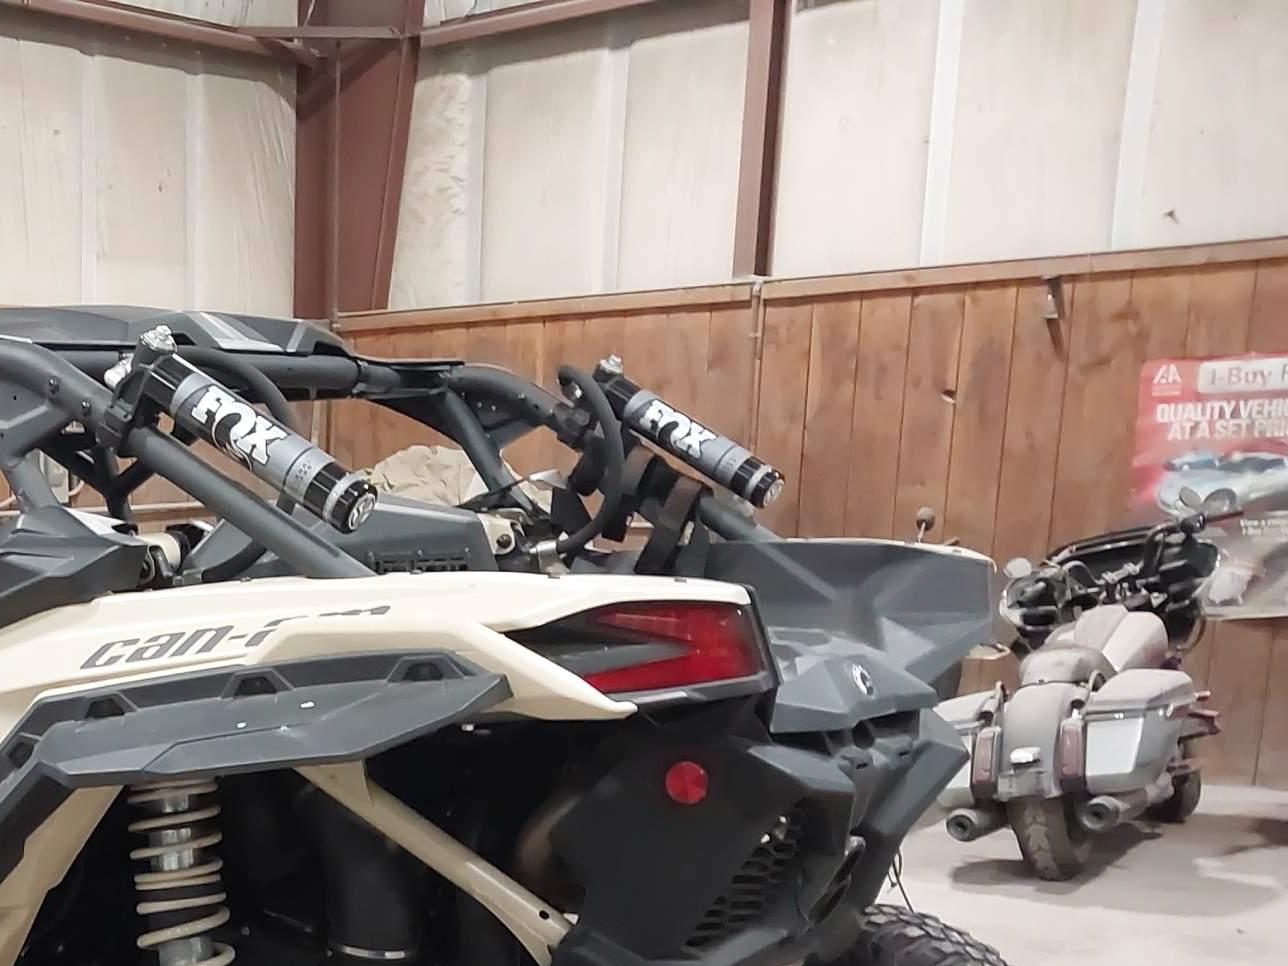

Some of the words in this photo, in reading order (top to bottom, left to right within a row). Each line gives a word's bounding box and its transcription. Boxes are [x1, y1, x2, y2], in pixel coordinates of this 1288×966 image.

[191, 386, 288, 466] FOX
[639, 399, 718, 459] FOX
[1156, 400, 1236, 423] QUALITY
[1168, 421, 1195, 441] AT
[1197, 420, 1210, 439] A
[1215, 419, 1251, 439] SET
[1254, 417, 1288, 438] PRI
